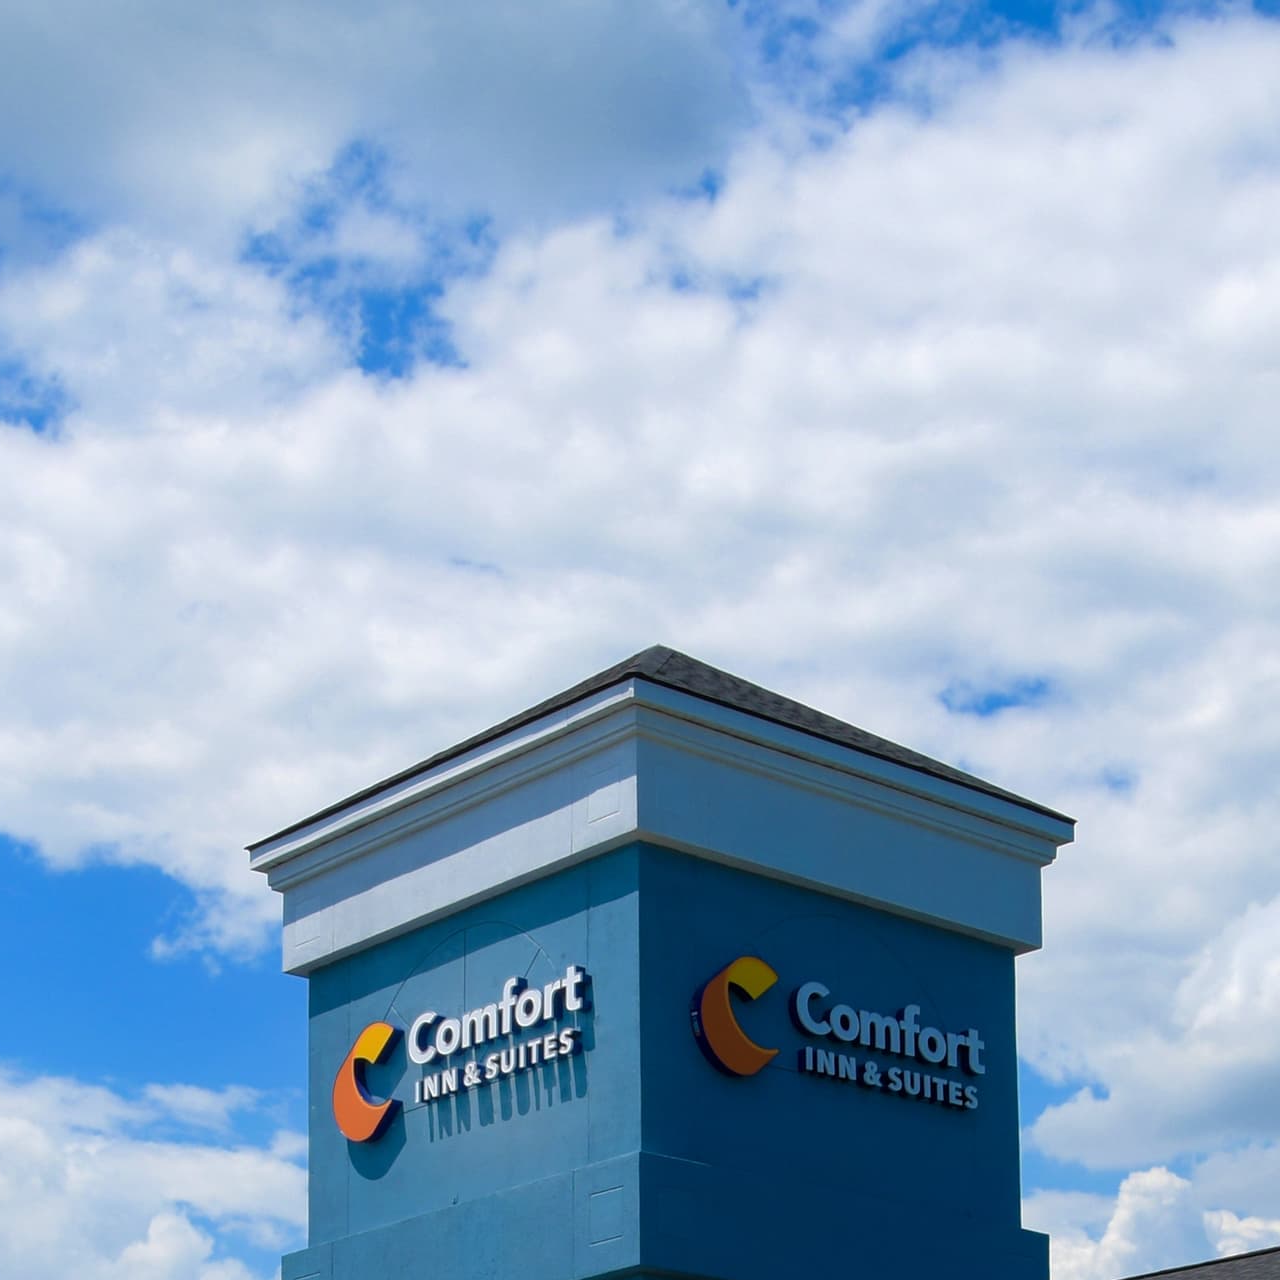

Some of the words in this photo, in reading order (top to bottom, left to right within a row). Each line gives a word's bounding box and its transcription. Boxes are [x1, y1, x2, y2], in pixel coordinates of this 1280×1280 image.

[408, 965, 583, 1064] Comfort
[796, 981, 986, 1075] Comfort
[415, 1068, 458, 1103] INN
[463, 1061, 482, 1087] &
[485, 1028, 575, 1080] SUITES
[805, 1046, 857, 1081] INN
[863, 1061, 883, 1088] &
[887, 1067, 978, 1109] SUITES
